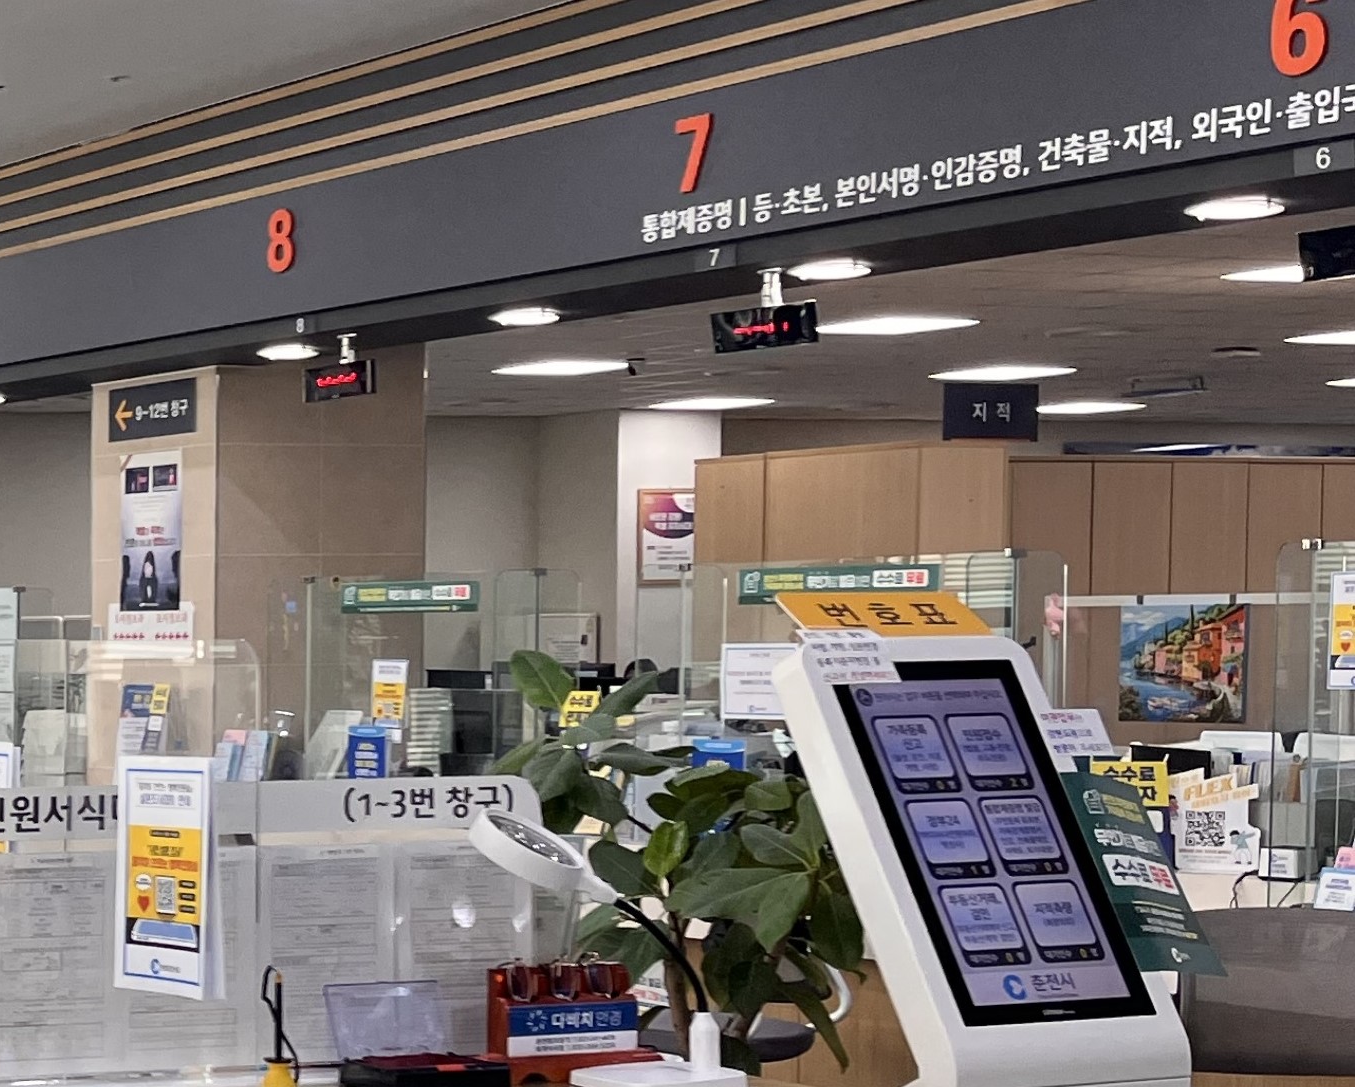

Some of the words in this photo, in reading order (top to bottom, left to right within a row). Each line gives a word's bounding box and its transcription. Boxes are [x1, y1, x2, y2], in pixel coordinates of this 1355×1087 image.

[1270, 0, 1329, 77] 6
[674, 112, 713, 194] 7
[1314, 147, 1332, 170] 6
[641, 199, 732, 244] 통합제증명
[753, 182, 829, 224] 등·초본,
[835, 144, 1031, 209] 본인서명·인감증명,
[1037, 115, 1183, 173] 건축물·지적,
[266, 207, 296, 274] 8
[708, 248, 721, 268] 7
[295, 317, 306, 334] 8
[171, 398, 190, 418] 창구
[817, 602, 959, 629] 번호표
[1183, 775, 1235, 802] FLEX
[344, 785, 436, 822] (1~3번
[445, 783, 514, 819] 창구)
[1030, 972, 1077, 992] 춘천시
